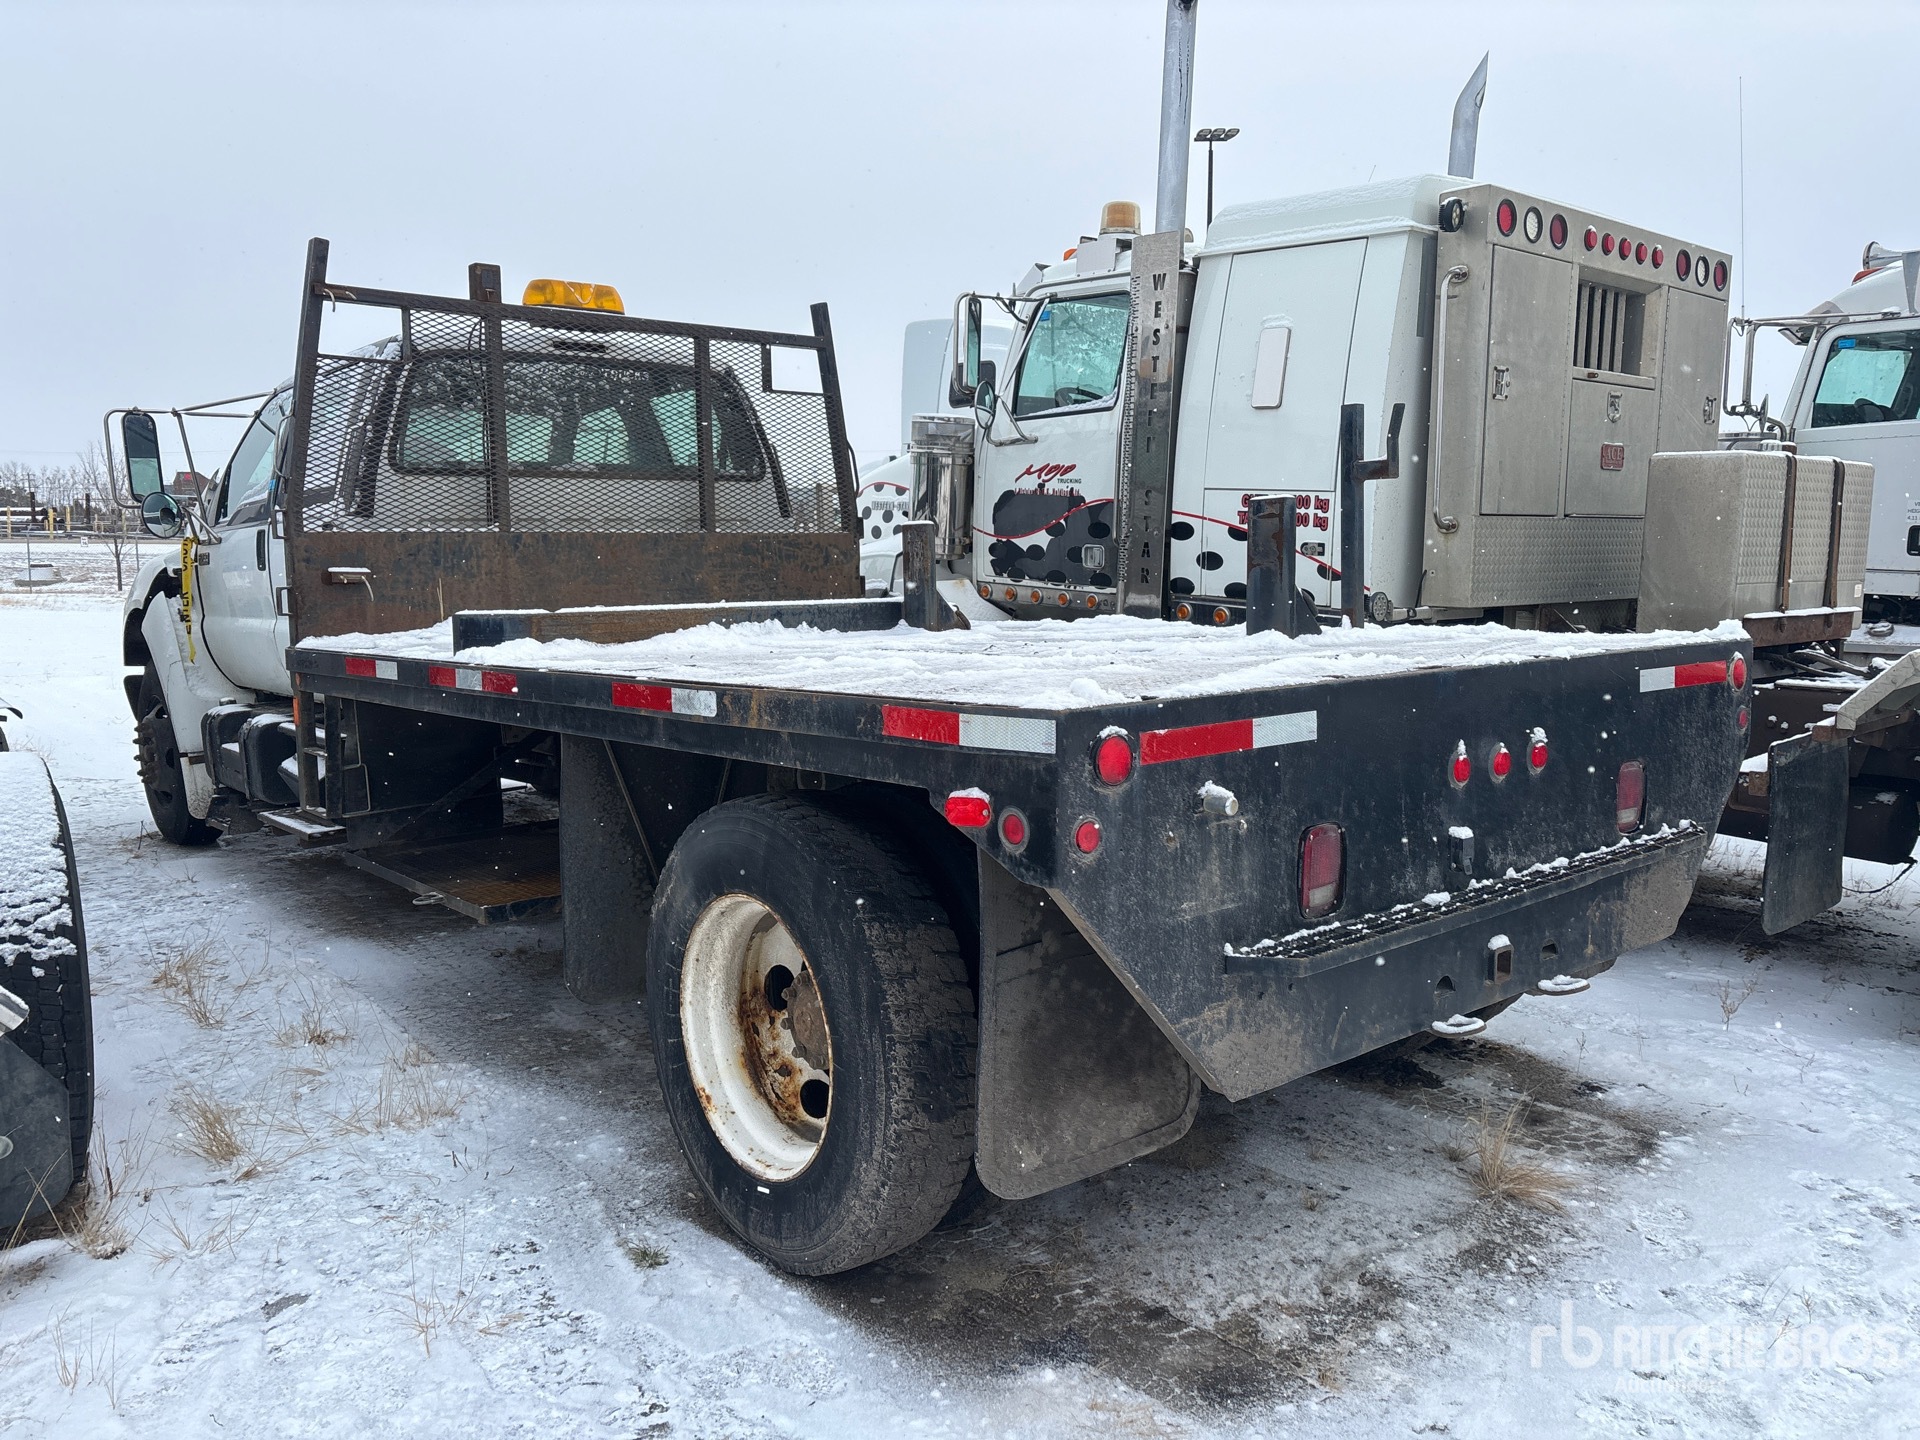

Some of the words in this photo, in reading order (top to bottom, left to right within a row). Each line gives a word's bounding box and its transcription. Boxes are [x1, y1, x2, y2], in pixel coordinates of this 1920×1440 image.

[1607, 447, 1622, 460] ACE
[1314, 495, 1330, 513] kg
[1312, 513, 1329, 531] kg
[1140, 489, 1153, 584] STAR
